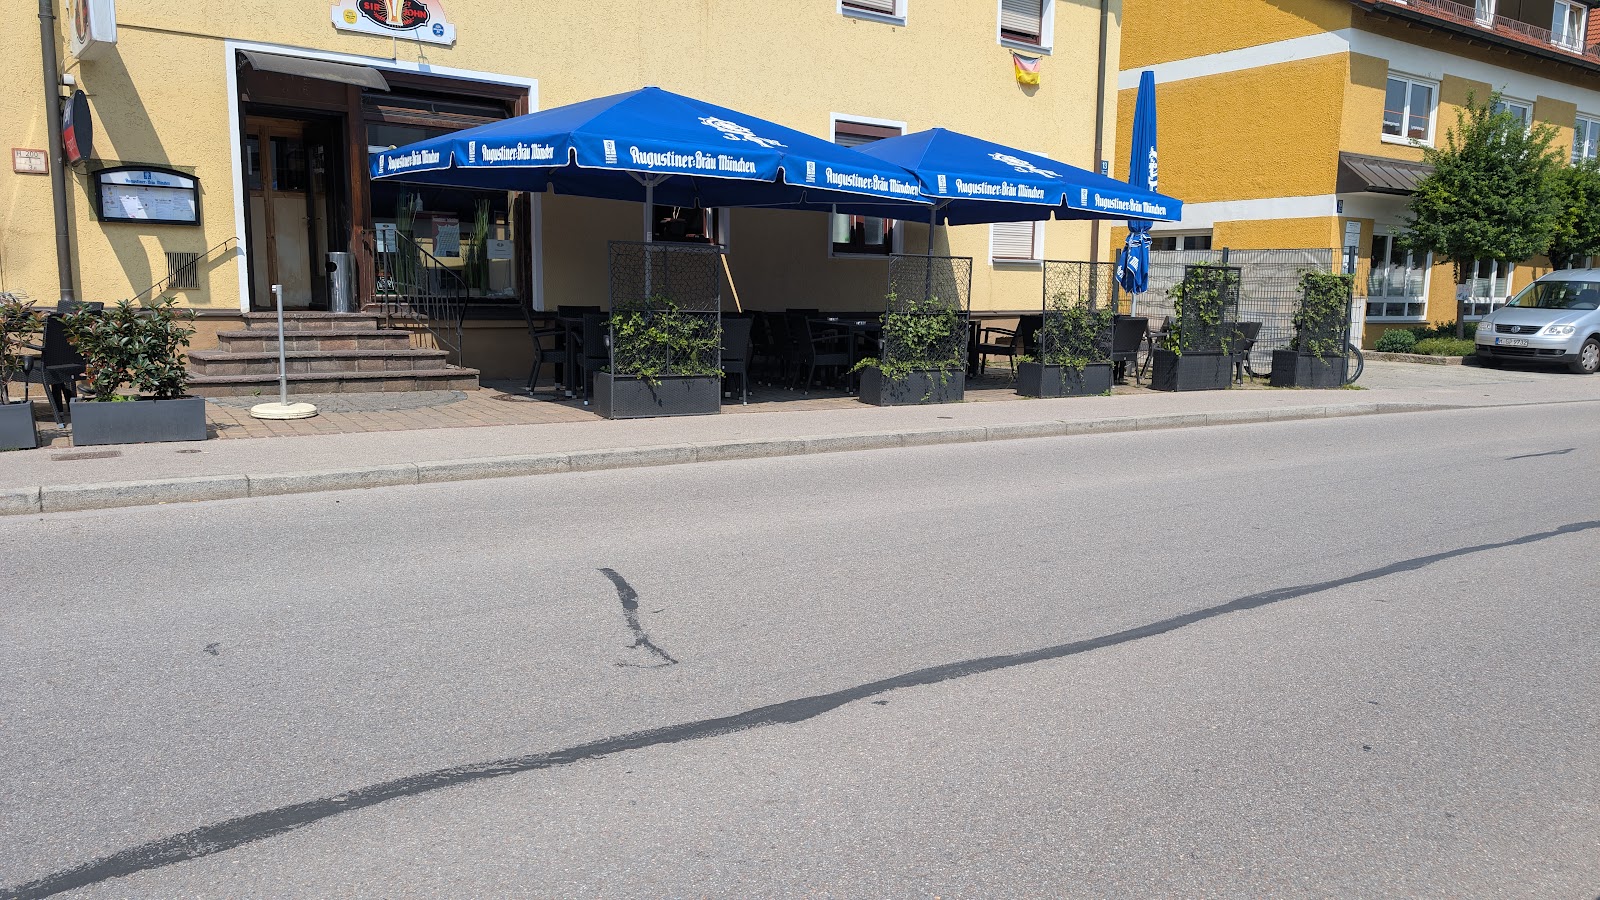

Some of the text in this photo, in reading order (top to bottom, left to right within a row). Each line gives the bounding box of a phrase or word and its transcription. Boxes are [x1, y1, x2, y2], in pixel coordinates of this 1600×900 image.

[364, 2, 380, 11] SIR
[404, 8, 427, 18] JOHN
[717, 154, 757, 174] München
[1102, 161, 1108, 170] 13
[889, 178, 919, 196] München
[1017, 184, 1045, 199] München
[1143, 201, 1167, 216] München
